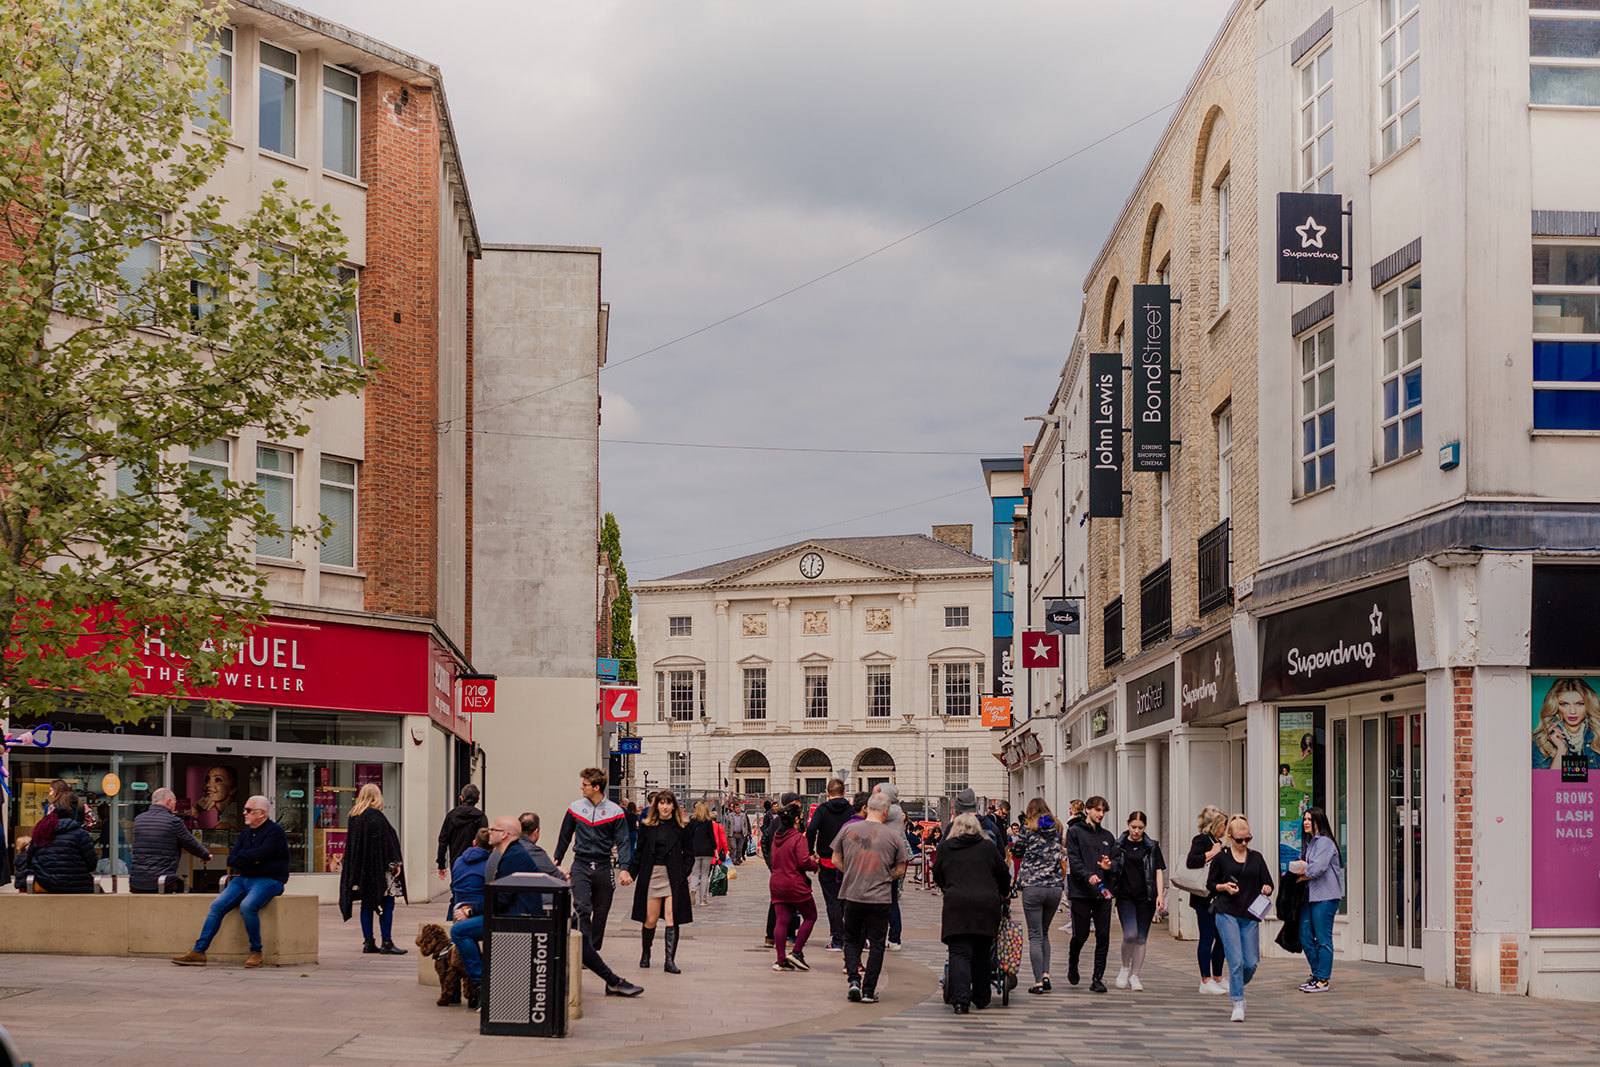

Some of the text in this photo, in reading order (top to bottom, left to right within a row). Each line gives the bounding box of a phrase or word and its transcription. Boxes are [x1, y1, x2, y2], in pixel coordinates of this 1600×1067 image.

[1283, 249, 1339, 260] Superdrug
[1142, 303, 1162, 423] BondStreet
[1095, 374, 1118, 471] John Lewis
[1287, 640, 1376, 678] Superdrug
[144, 666, 185, 682] THE
[1182, 679, 1218, 709] Superdrug
[983, 701, 1006, 714] Tapas
[990, 710, 1009, 722] Bar
[1556, 792, 1593, 804] BROWS
[1556, 810, 1593, 822] LASH
[1556, 828, 1593, 838] NAILS
[531, 932, 548, 1024] Chelmsford
